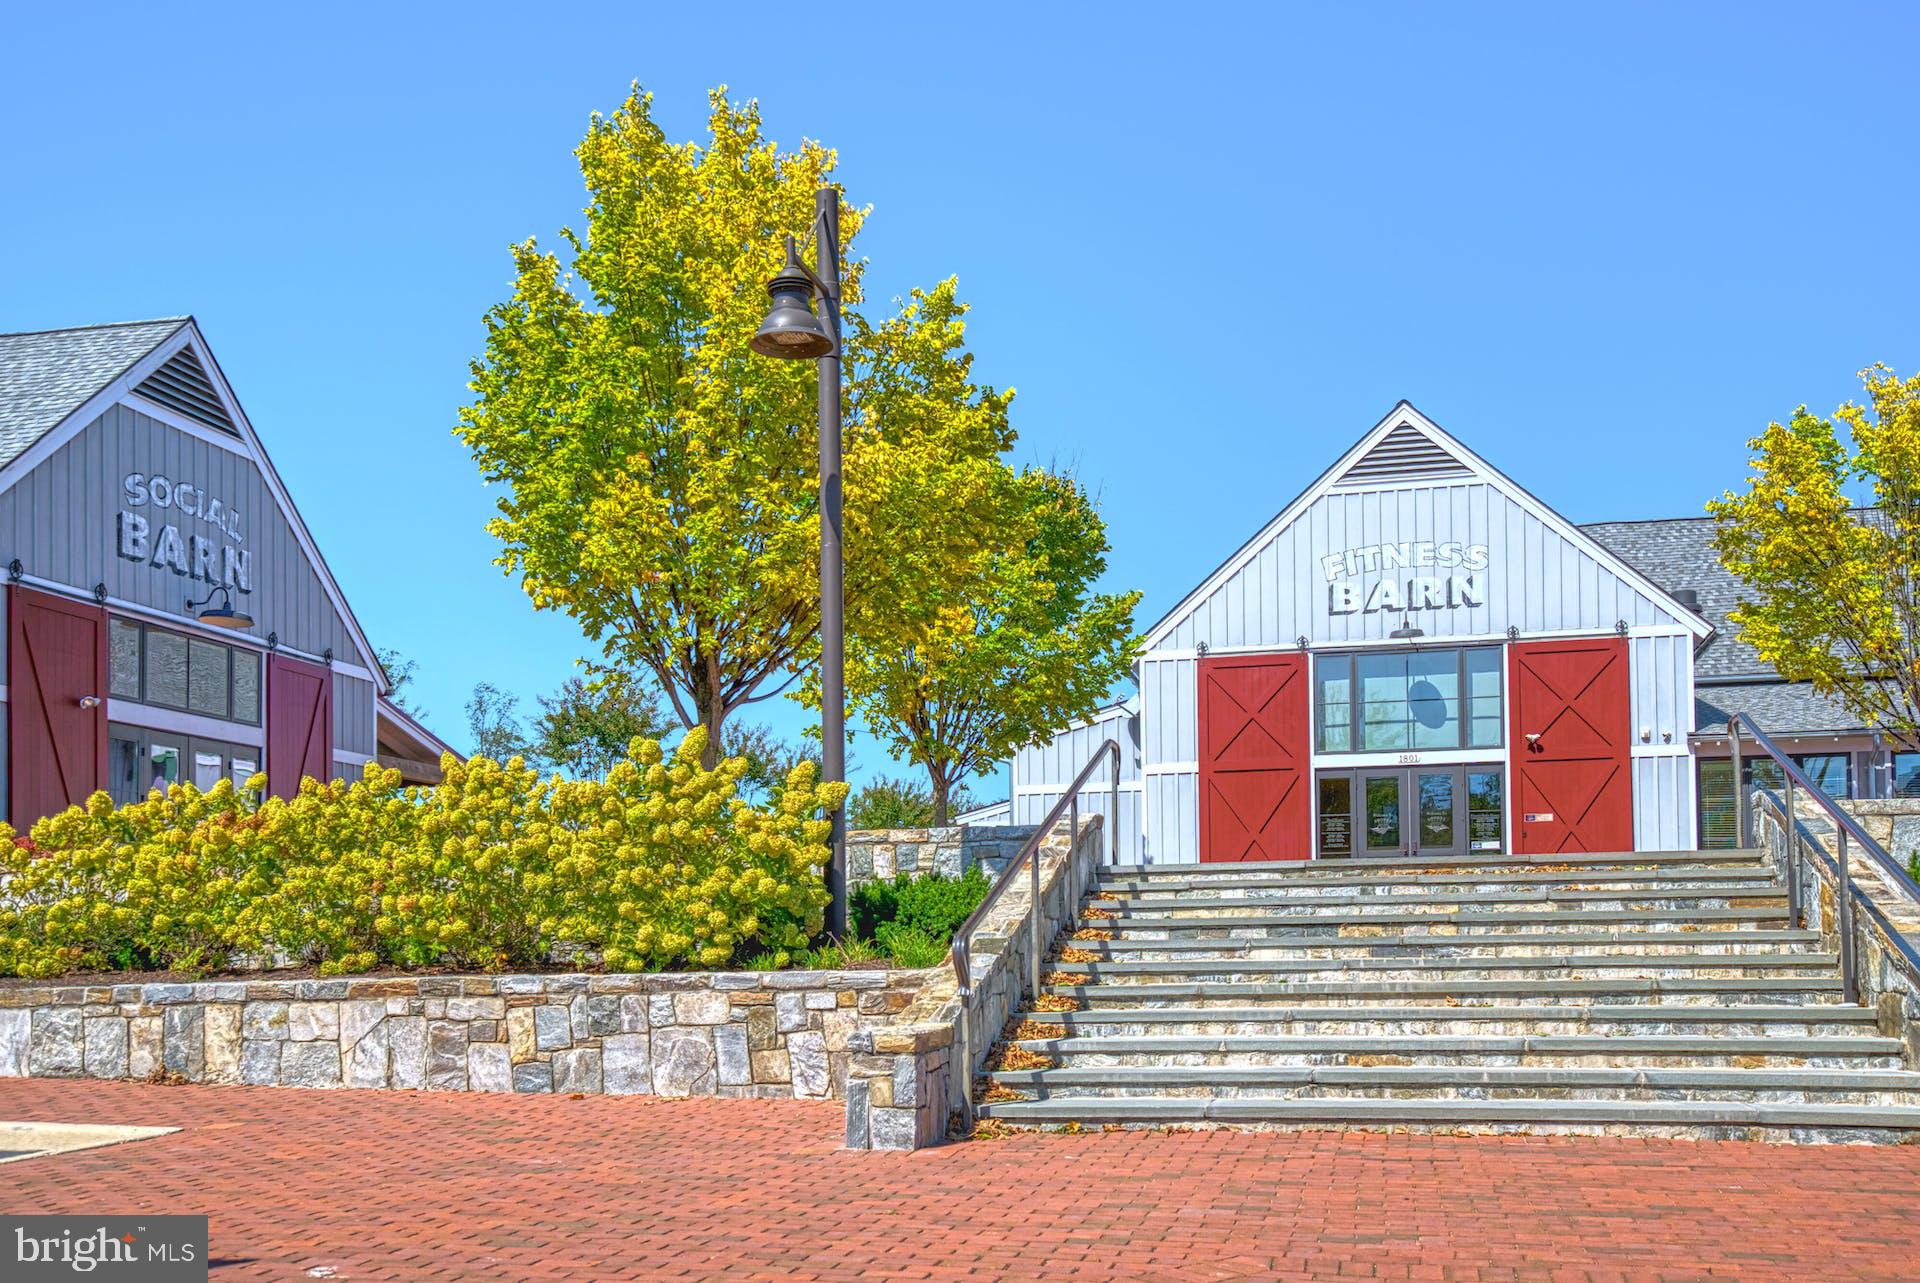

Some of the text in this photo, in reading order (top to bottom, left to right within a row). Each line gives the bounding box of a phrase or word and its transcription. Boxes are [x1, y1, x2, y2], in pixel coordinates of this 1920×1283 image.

[124, 472, 244, 544] SOCIAL
[117, 510, 252, 595] BARN
[1320, 541, 1489, 582] FITNESS
[1328, 574, 1485, 616] BARN
[1399, 754, 1420, 764] 1801
